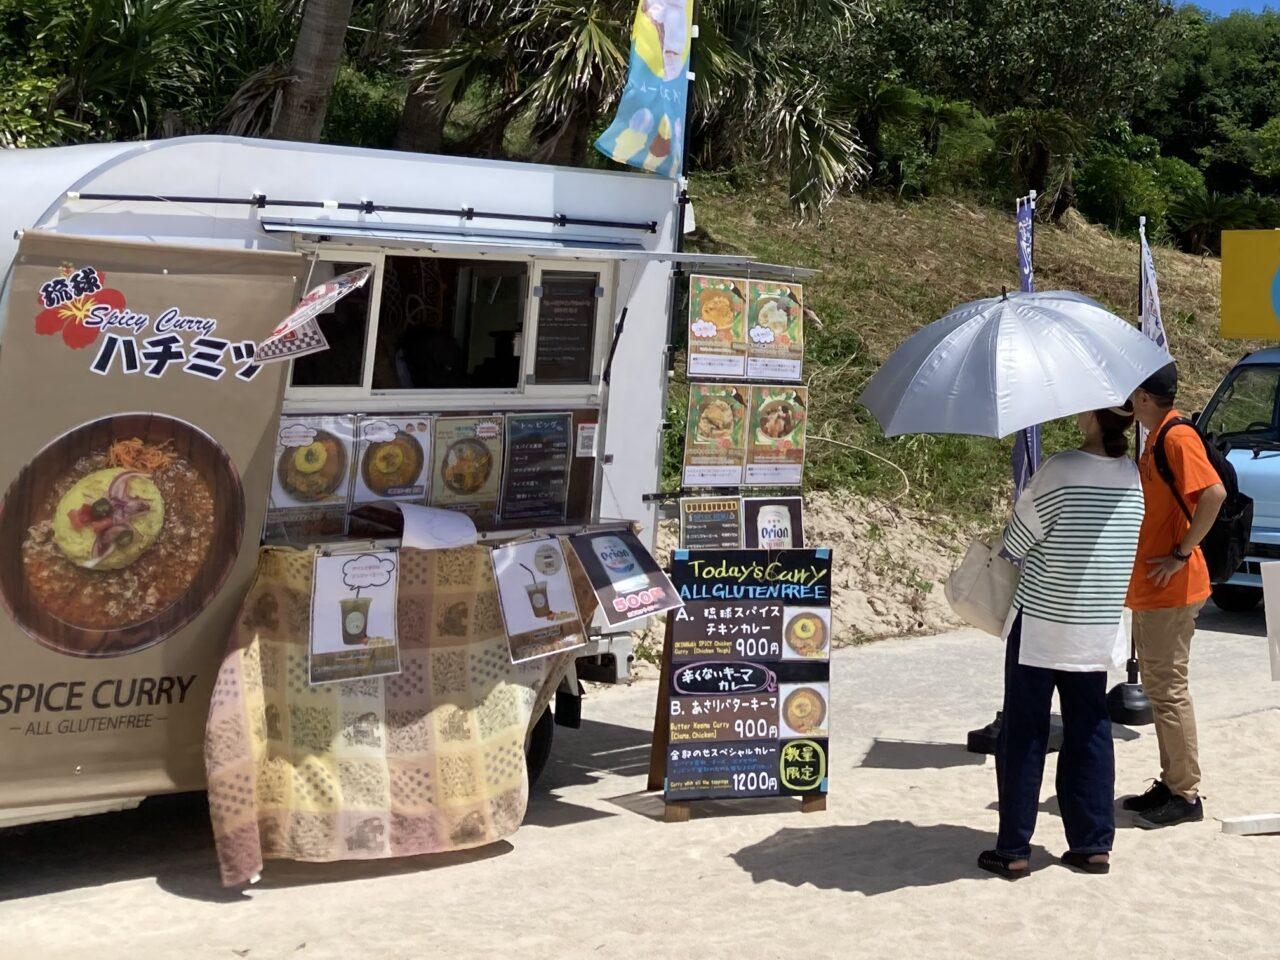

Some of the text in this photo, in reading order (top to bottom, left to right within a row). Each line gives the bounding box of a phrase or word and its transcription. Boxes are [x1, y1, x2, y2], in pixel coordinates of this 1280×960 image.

[41, 267, 101, 307] 琉球
[84, 307, 216, 335] Spicy Curry
[90, 334, 265, 381] ハチミツ
[761, 524, 789, 539] Orion
[765, 561, 828, 587] Curry
[680, 584, 709, 599] ALL
[706, 623, 771, 635] チキンカレー
[735, 638, 780, 657] 900円
[682, 666, 753, 684] 辛くないキーマ
[718, 680, 757, 691] カレー
[0, 675, 198, 715] SPICE CURRY
[691, 697, 777, 715] あさりバターキーマ
[25, 714, 153, 736] ALL GLUTENFREE
[735, 718, 778, 738] 900円
[670, 746, 776, 761] 全部のせスペシャルカレー
[784, 745, 816, 762] 数量
[732, 771, 778, 791] 1200円
[786, 766, 819, 781] 限定
